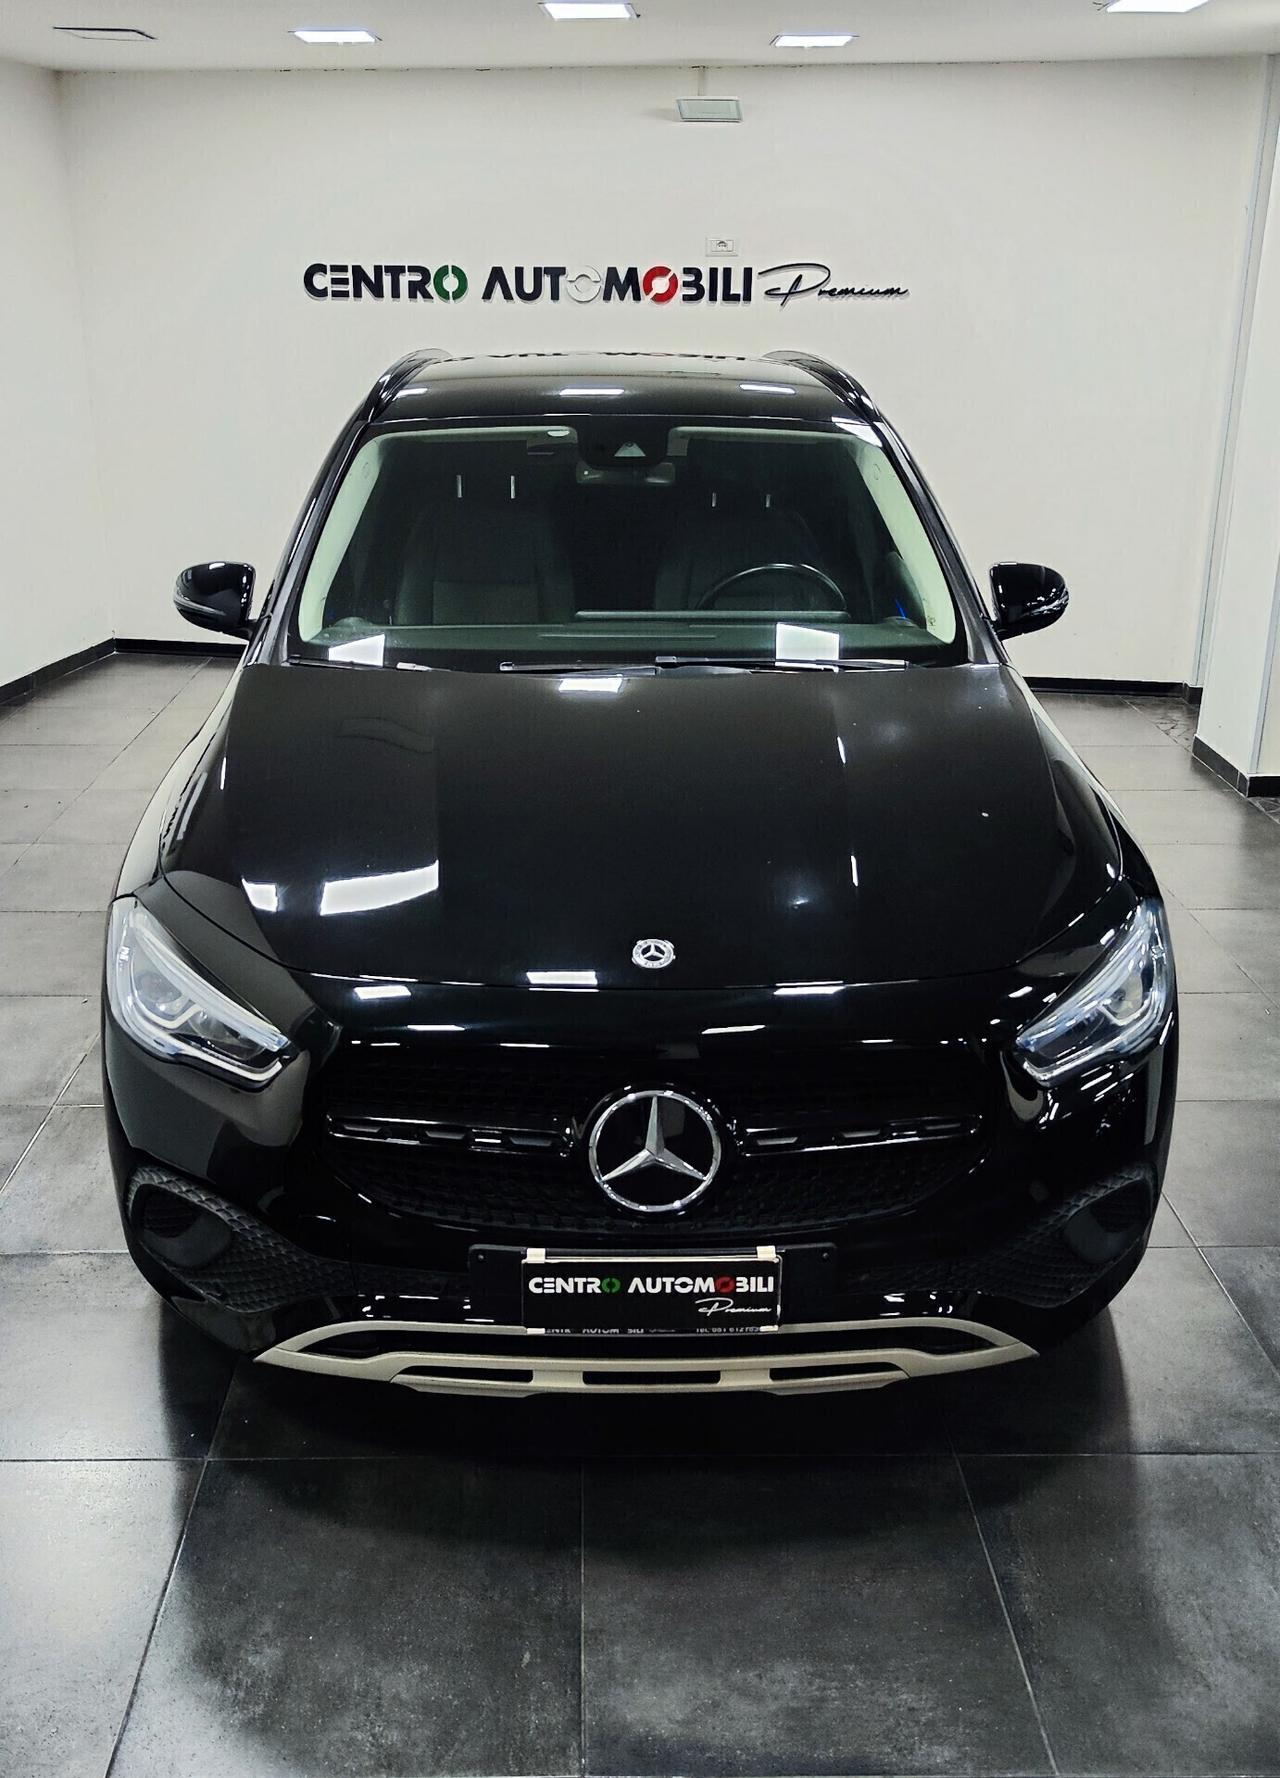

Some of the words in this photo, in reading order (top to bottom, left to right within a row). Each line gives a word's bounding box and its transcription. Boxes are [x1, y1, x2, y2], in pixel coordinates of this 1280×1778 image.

[303, 263, 468, 303] CENTRO
[481, 264, 754, 304] AUTOMOBILI
[757, 261, 911, 310] Premium
[528, 1276, 621, 1294] CENTRO
[627, 1275, 774, 1295] AUTOMOBILI
[695, 1297, 772, 1317] Premium
